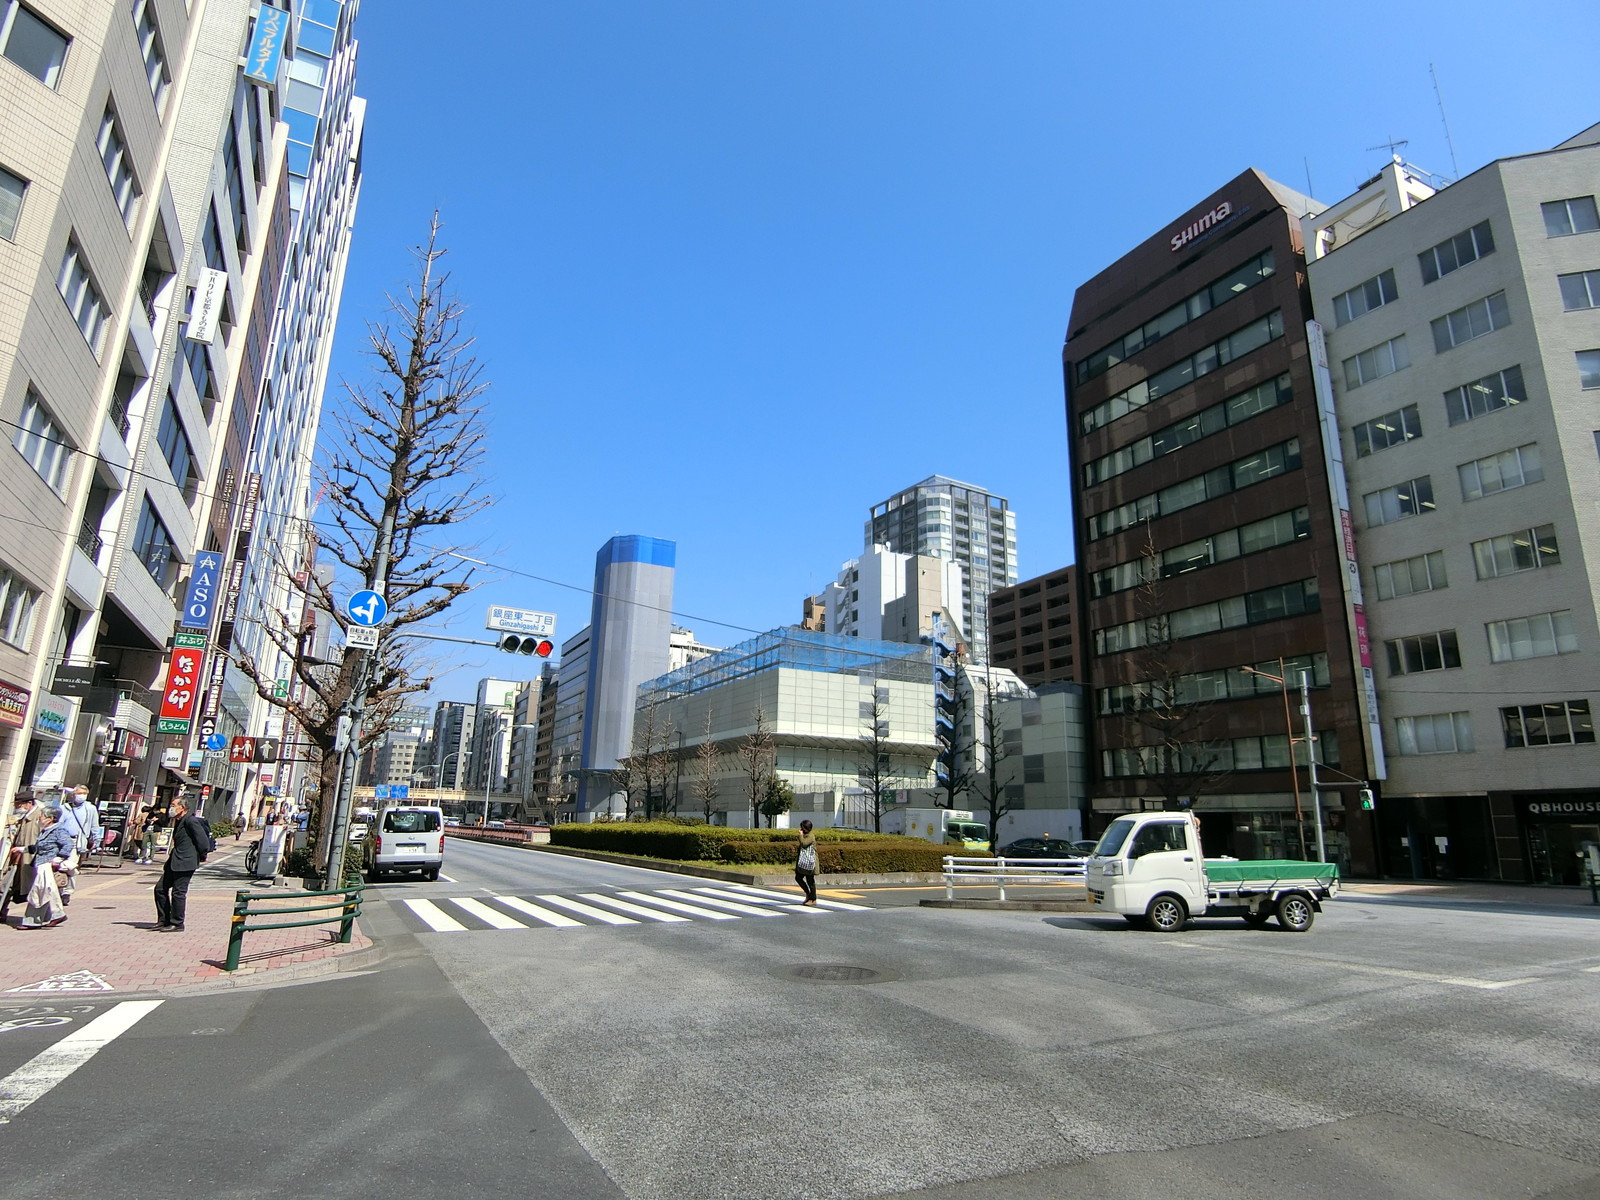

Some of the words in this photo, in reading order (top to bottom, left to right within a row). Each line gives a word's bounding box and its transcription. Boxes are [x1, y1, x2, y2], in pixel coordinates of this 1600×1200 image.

[252, 9, 281, 79] リベラルタイム
[189, 572, 212, 618] ASO
[492, 608, 553, 626] 銀座東二丁目
[499, 619, 539, 631] Ginzahigashi
[177, 636, 204, 646] 丼ぶり
[349, 635, 376, 643] 一方通行
[168, 655, 195, 711] なか卯
[167, 723, 187, 731] うどん
